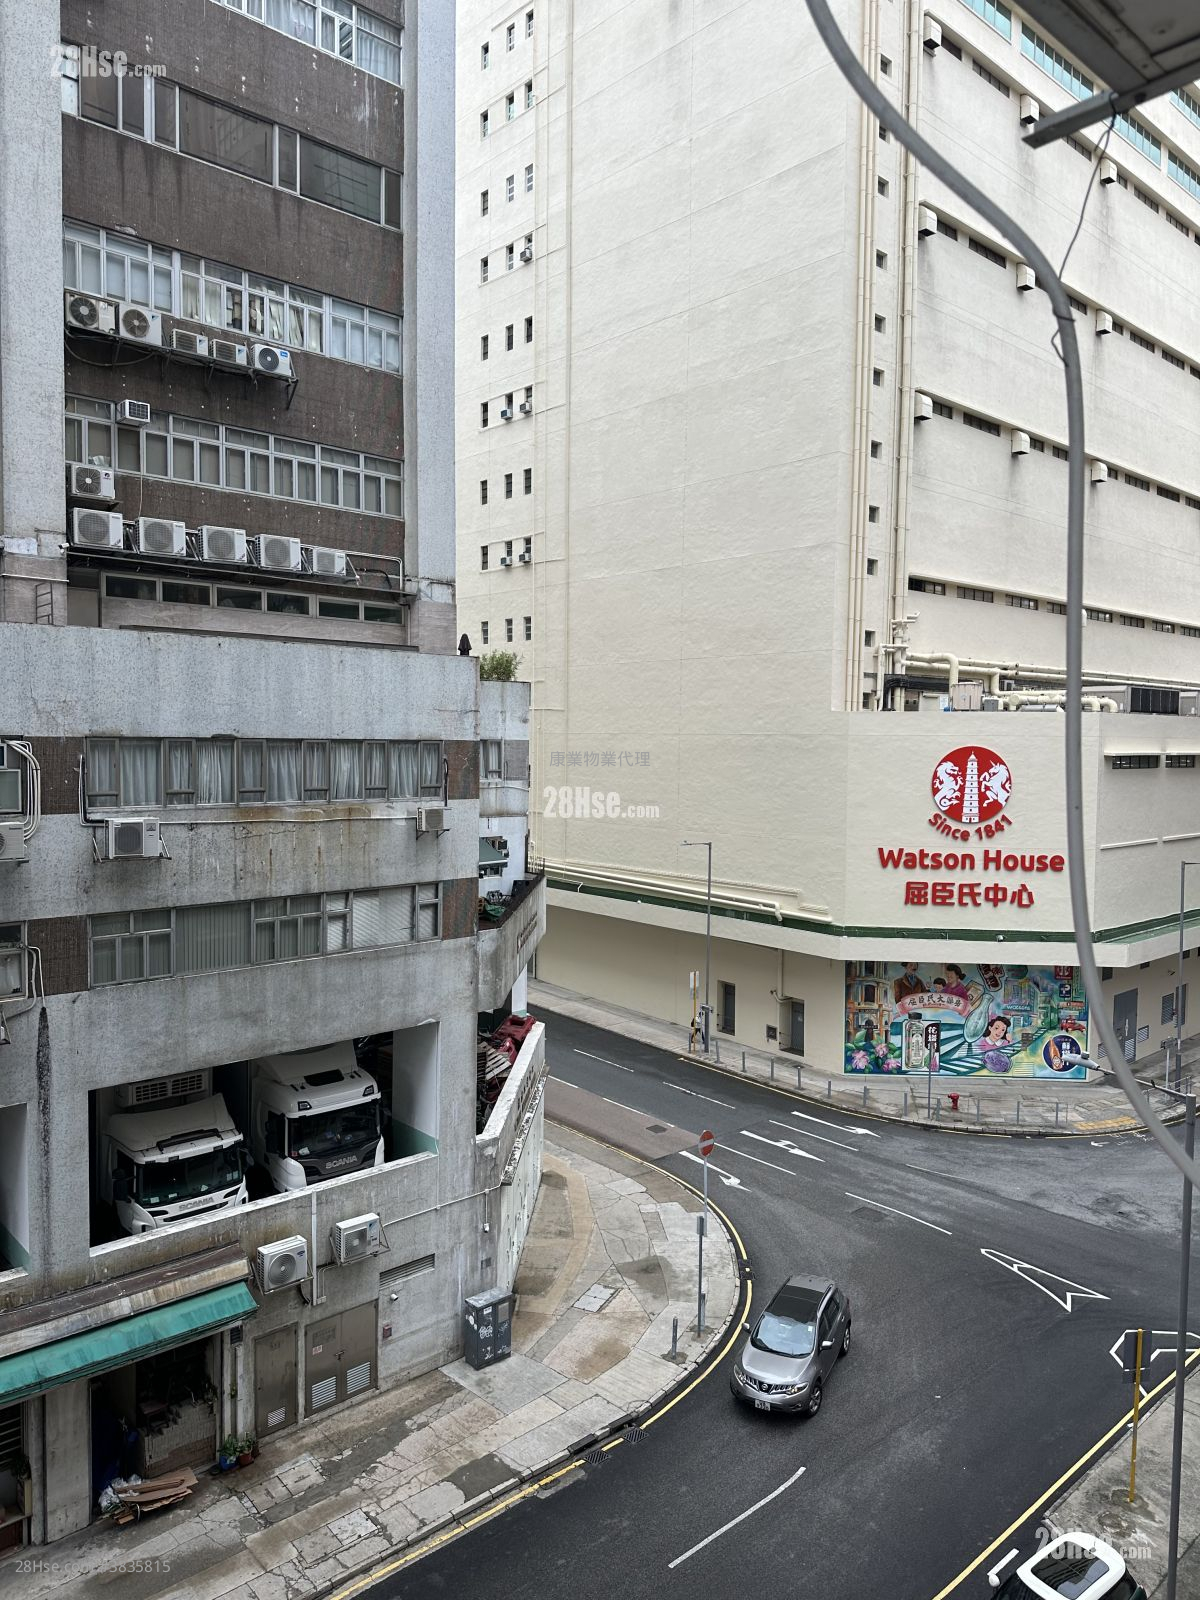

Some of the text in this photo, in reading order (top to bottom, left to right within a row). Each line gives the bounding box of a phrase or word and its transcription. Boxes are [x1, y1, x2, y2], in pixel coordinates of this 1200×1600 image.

[928, 813, 1013, 841] Since 1841
[878, 847, 1065, 873] Watson House
[904, 881, 1035, 908] 屈臣氏中心
[325, 1155, 358, 1169] SCANIA
[179, 1197, 215, 1211] SCANIA
